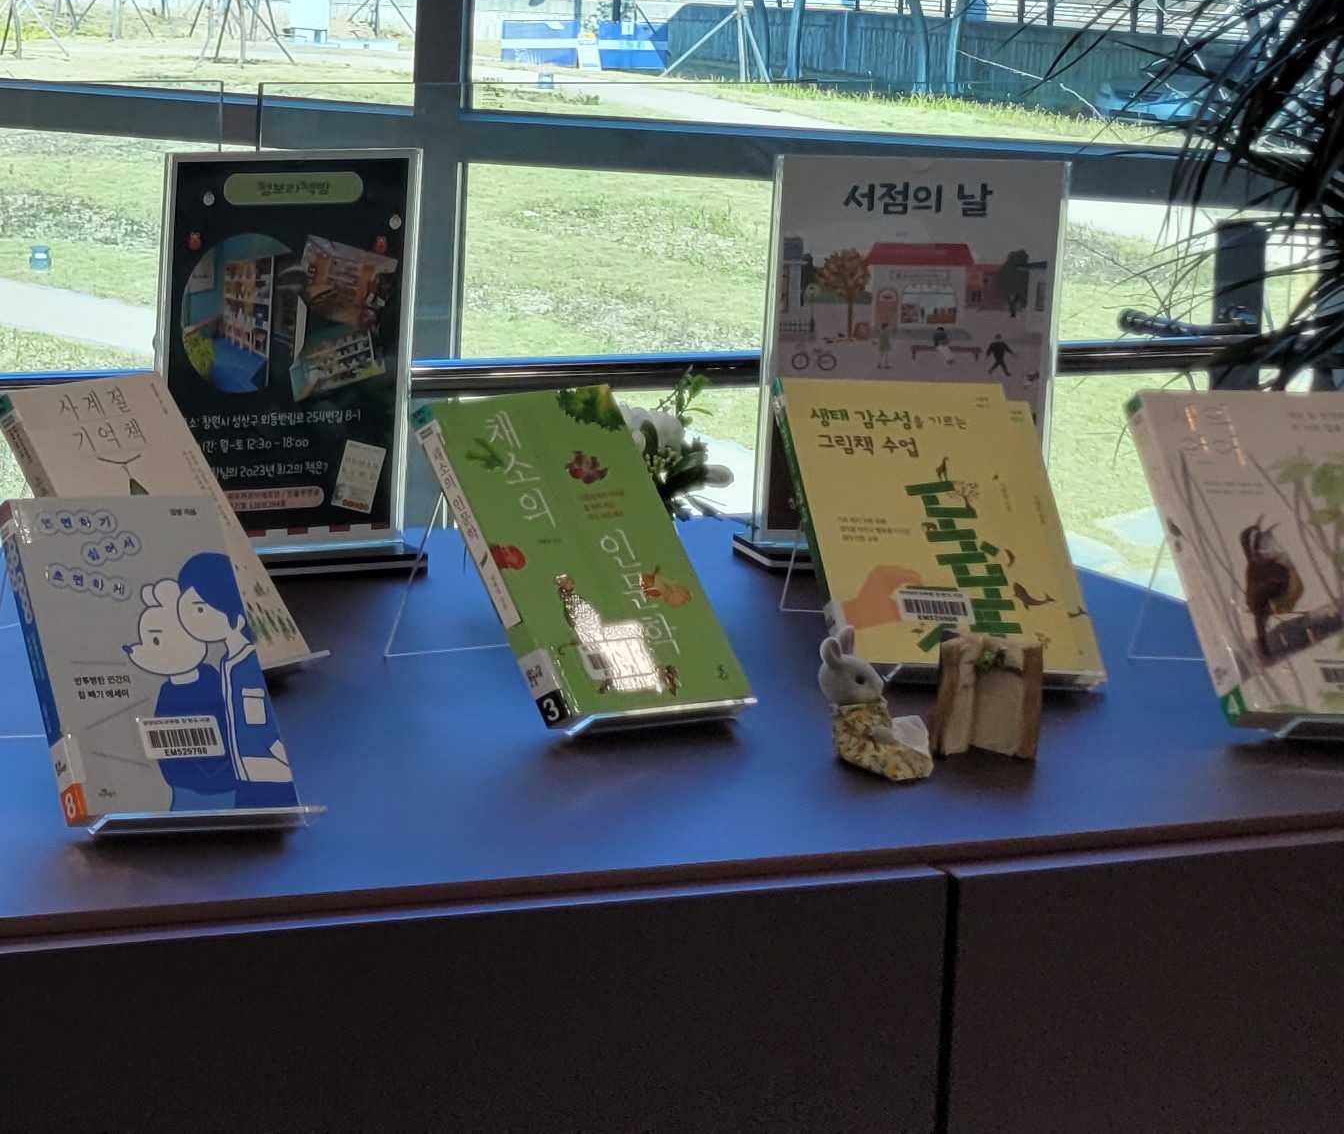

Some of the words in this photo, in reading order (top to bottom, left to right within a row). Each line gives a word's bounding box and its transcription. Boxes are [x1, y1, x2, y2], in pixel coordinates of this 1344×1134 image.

[843, 181, 942, 215] 서점의
[957, 183, 993, 217] 날
[59, 387, 131, 419] 사계절
[202, 415, 230, 428] 창원시
[232, 414, 259, 428] 성산구
[345, 409, 362, 421] 8-1
[810, 407, 850, 428] 생태
[854, 410, 923, 430] 감수성을
[928, 414, 968, 430] 기르는
[72, 417, 148, 452] 기억책
[247, 437, 272, 450] 12:30
[283, 436, 309, 448] 18:00
[817, 434, 875, 456] 그림책
[882, 436, 920, 458] 수업
[240, 465, 276, 479] 2023년
[277, 463, 303, 476] 최고의
[304, 461, 329, 475] 책은?
[483, 410, 557, 528] 채소의
[600, 529, 682, 657] 인문학
[542, 698, 561, 722] 3
[65, 792, 77, 819] 8
